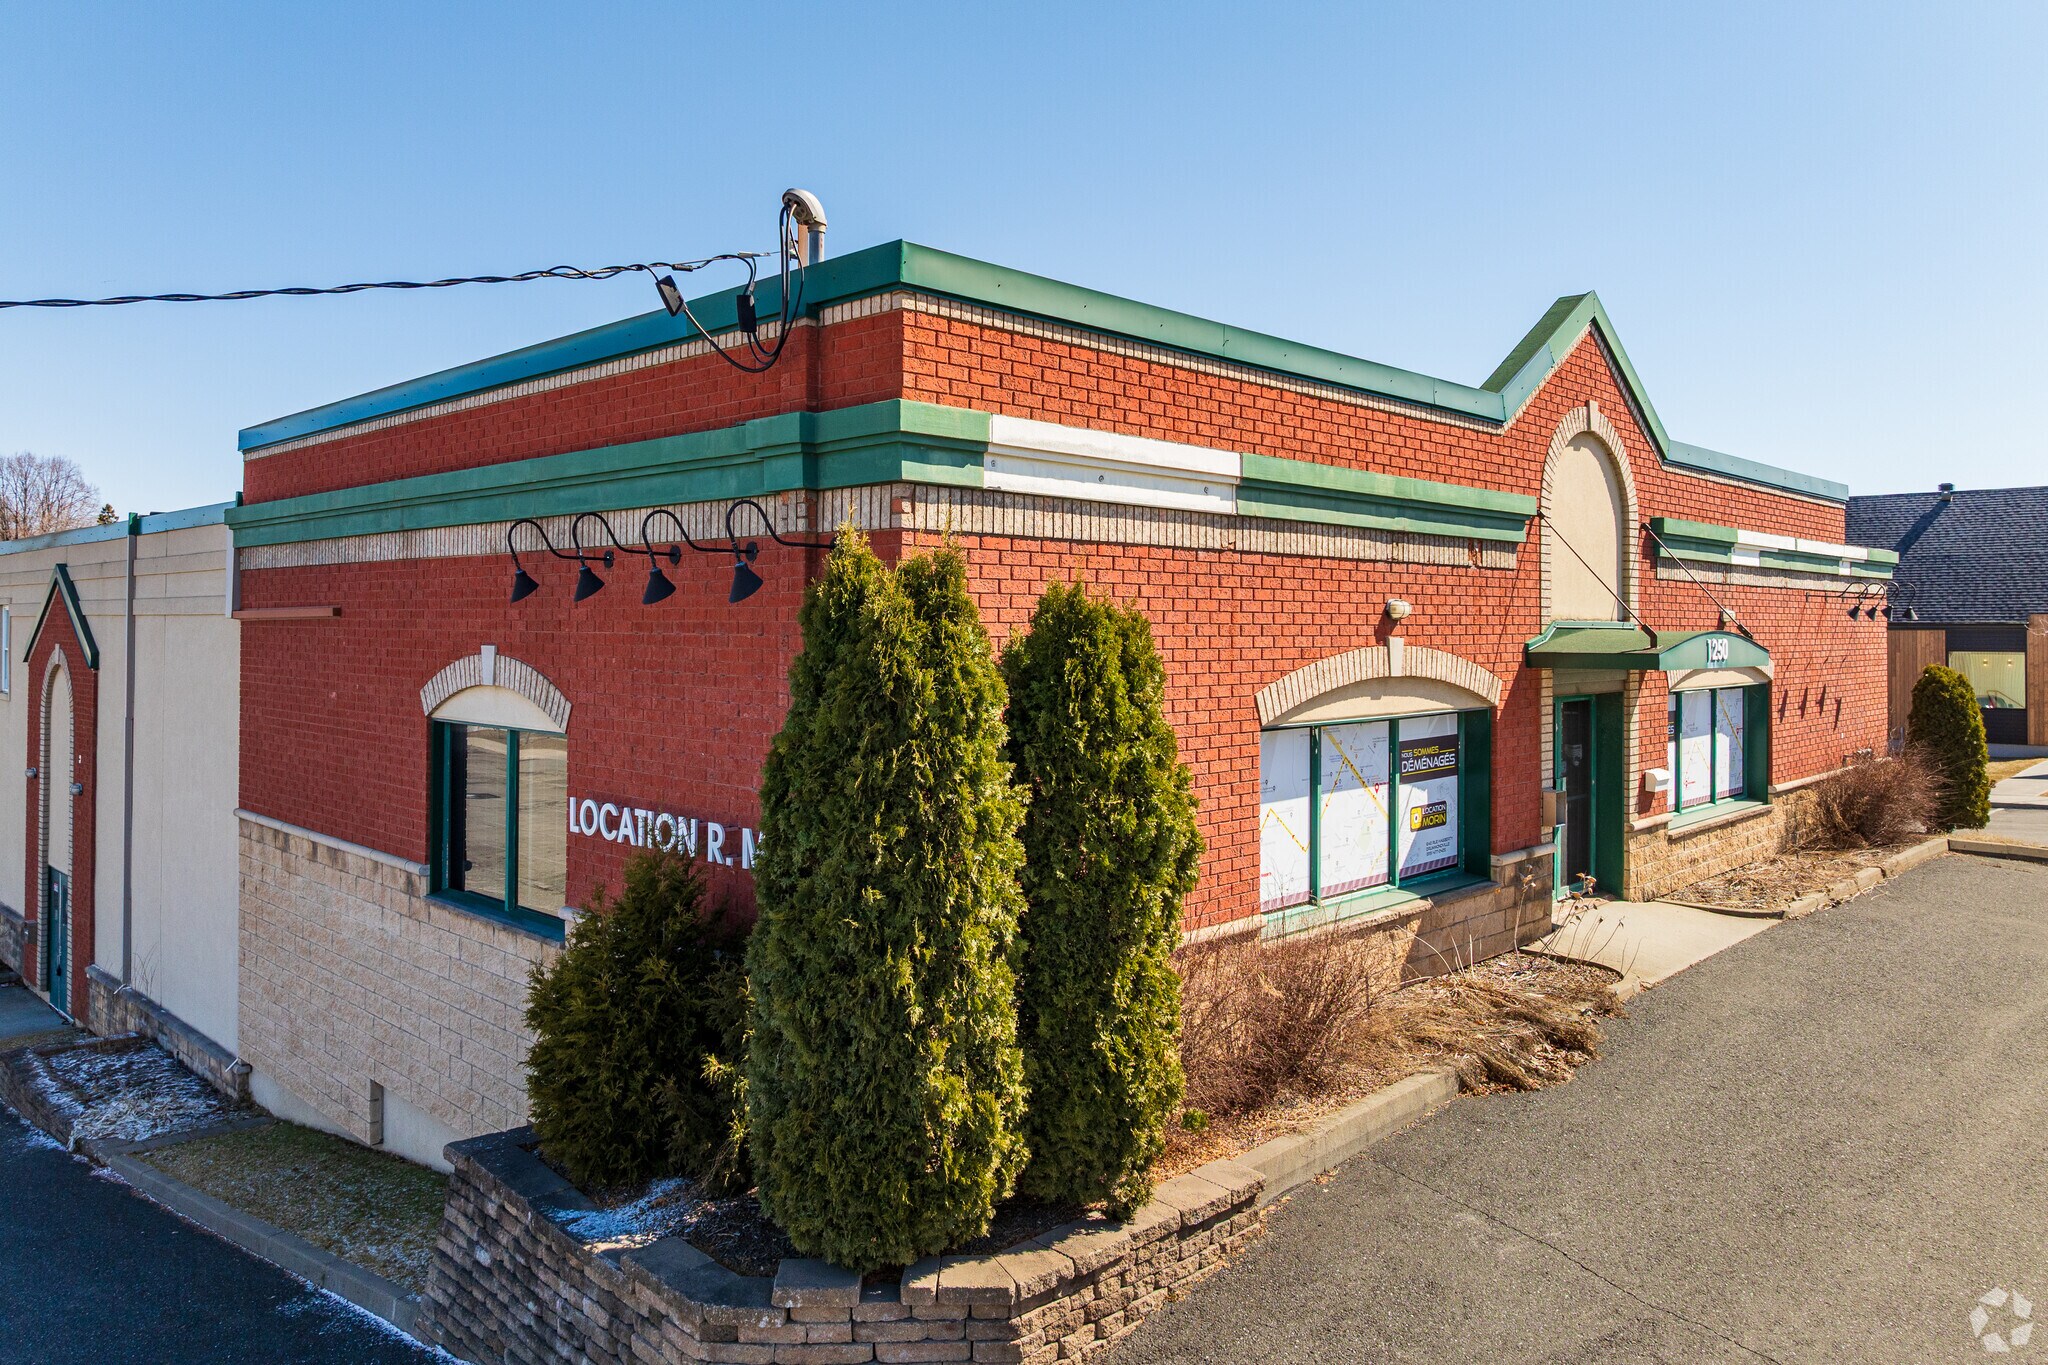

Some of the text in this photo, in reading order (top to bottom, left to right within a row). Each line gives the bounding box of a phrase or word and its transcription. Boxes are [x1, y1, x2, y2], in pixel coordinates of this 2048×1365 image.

[1706, 638, 1729, 661] 1250
[1413, 745, 1439, 757] SOMMES
[1401, 752, 1456, 773] DÉMÉNAGÉS
[1422, 804, 1446, 815] LOCATION
[1422, 813, 1446, 827] MORIN
[569, 797, 698, 858] LOCATION
[707, 822, 734, 866] R.
